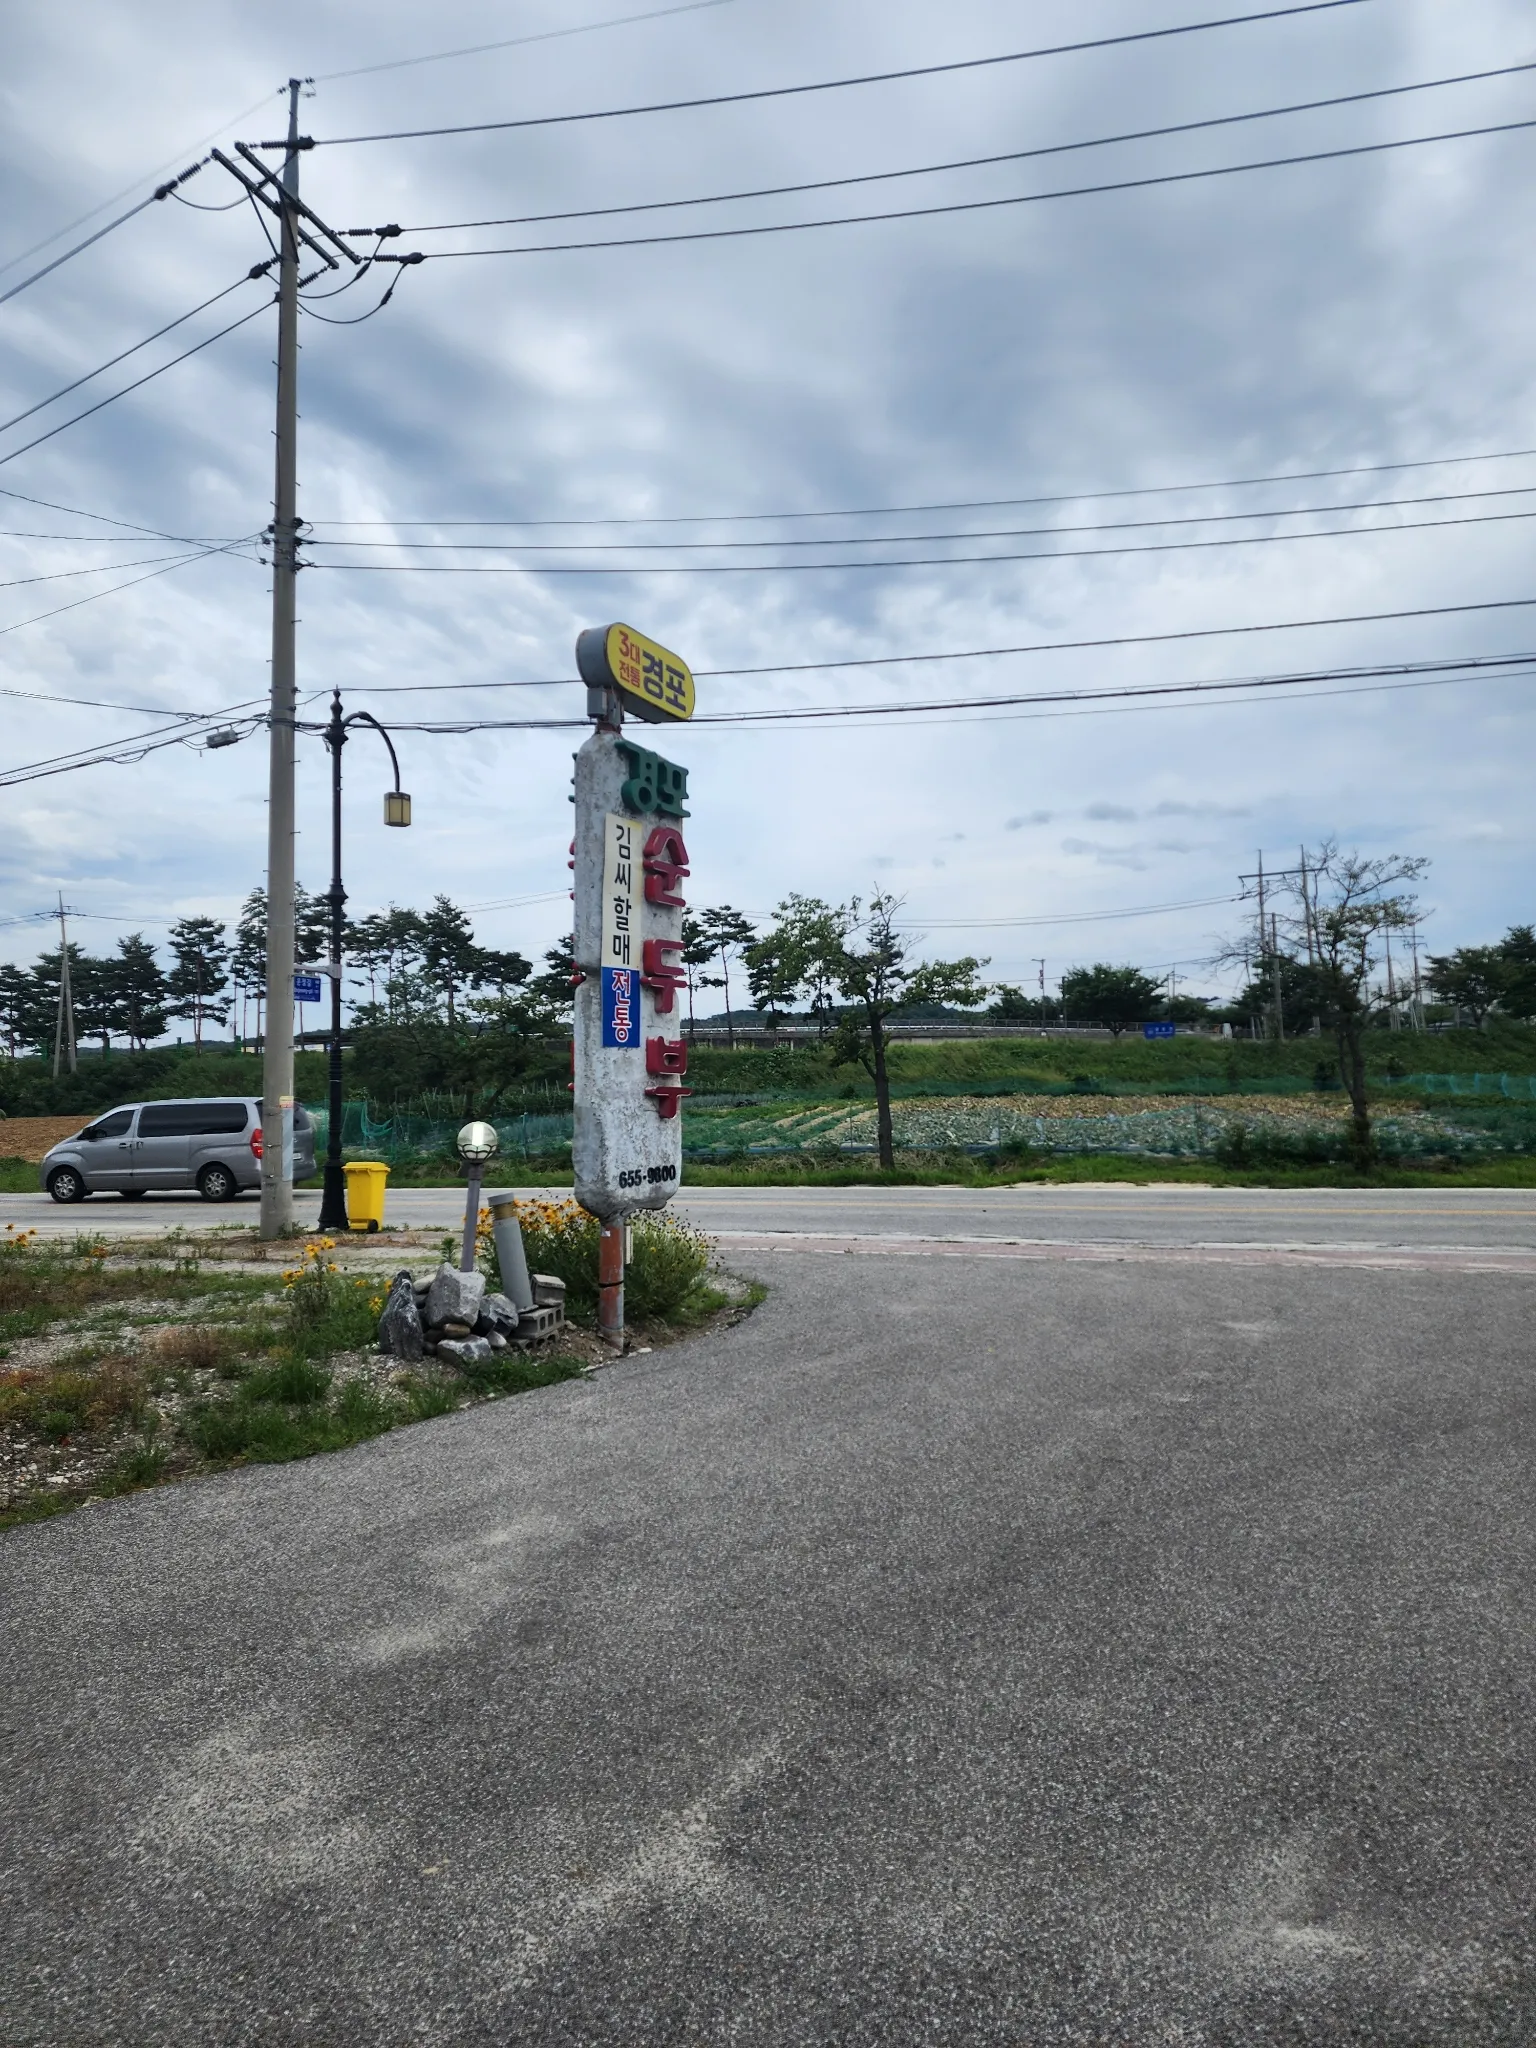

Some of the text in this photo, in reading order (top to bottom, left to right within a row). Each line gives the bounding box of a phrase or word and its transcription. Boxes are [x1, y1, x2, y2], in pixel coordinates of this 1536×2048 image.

[618, 630, 641, 664] 3대
[618, 660, 641, 688] 전통
[642, 649, 687, 712] 경포
[612, 824, 632, 966] 김씨할매
[611, 970, 632, 1043] 전통
[641, 827, 692, 1119] 순두부
